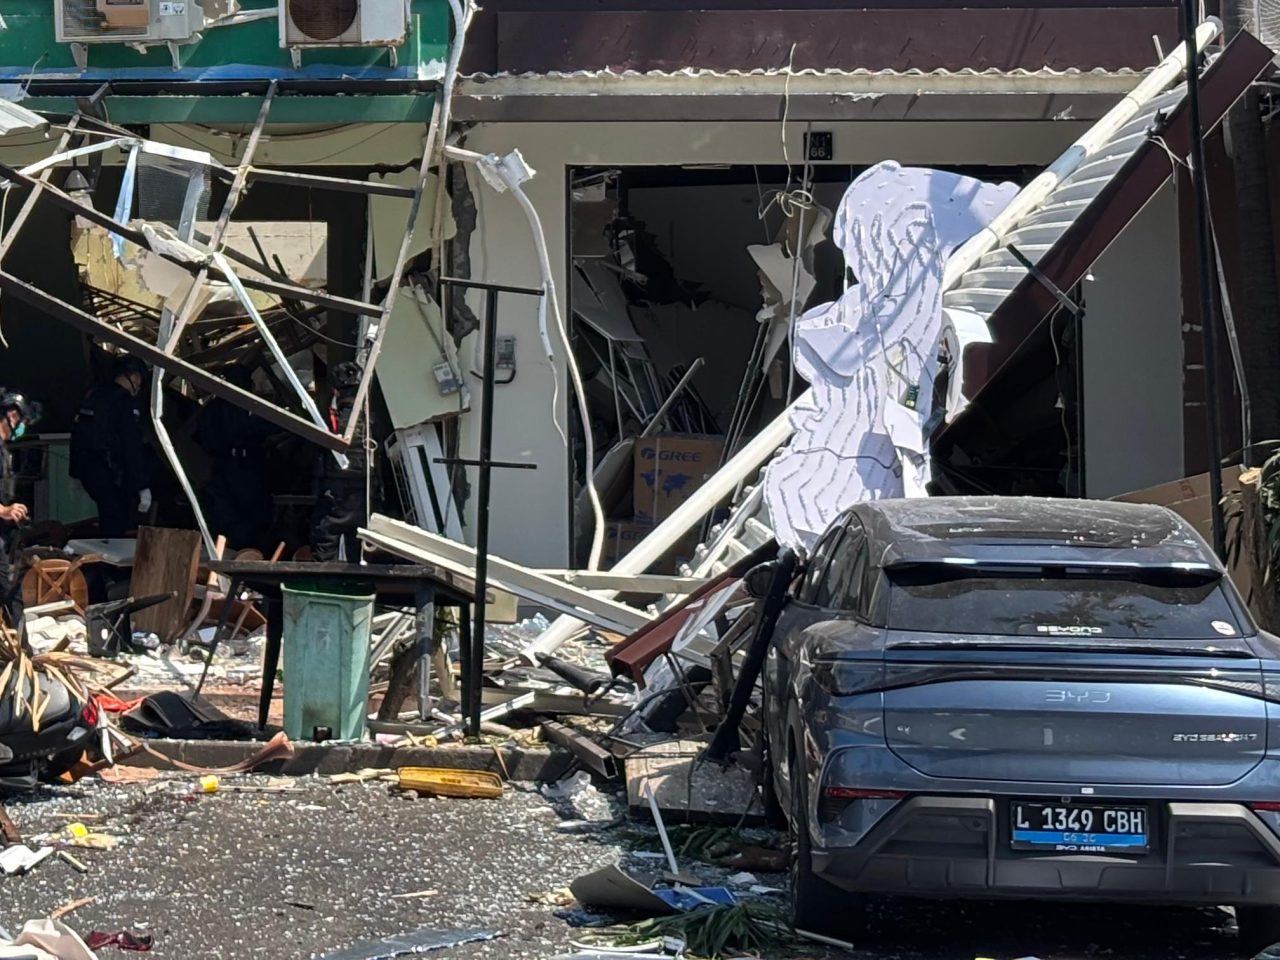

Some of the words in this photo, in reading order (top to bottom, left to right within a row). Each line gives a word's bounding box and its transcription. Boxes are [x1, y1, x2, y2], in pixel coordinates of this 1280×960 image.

[659, 450, 703, 462] GREE
[1017, 806, 1029, 828] L
[1041, 808, 1093, 831] 1349
[1103, 810, 1143, 833] CBH
